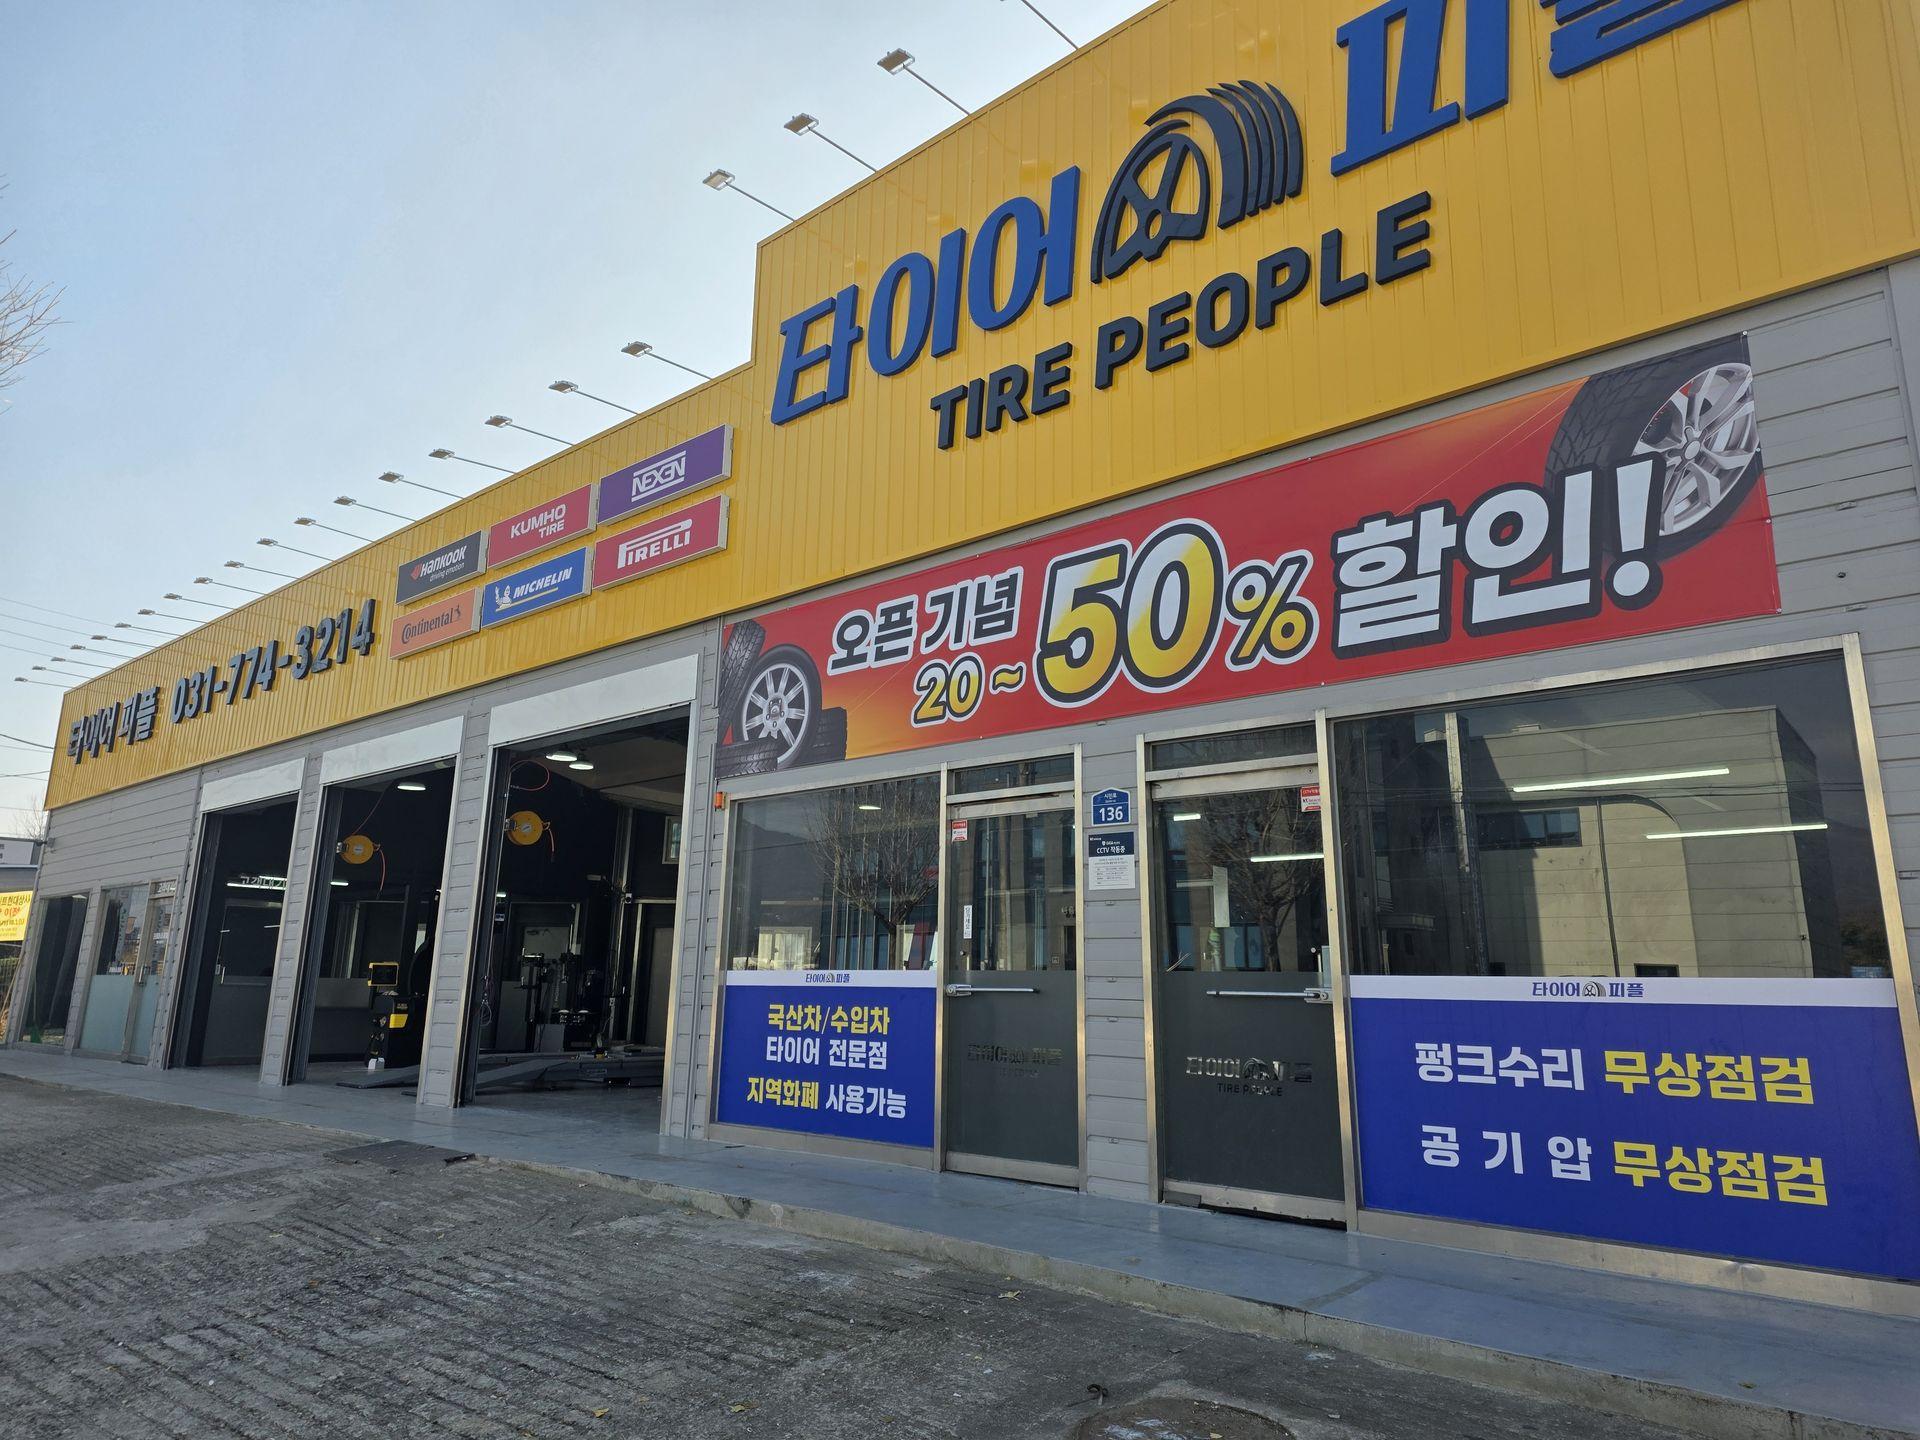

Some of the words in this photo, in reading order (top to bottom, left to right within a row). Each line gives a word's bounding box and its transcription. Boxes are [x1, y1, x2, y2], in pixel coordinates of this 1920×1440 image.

[772, 165, 1080, 425] 타이어
[930, 342, 1073, 450] TIRE
[1094, 191, 1431, 390] PEOPLE
[631, 453, 686, 500] NEXEN
[511, 503, 566, 539] KUMHO
[539, 519, 565, 539] TIRE
[617, 519, 692, 569] PIRELLI
[513, 566, 573, 599] MICHELIN
[1035, 518, 1319, 708] 50%
[1333, 454, 1664, 655] 할인!
[402, 608, 454, 644] Continental
[827, 595, 918, 676] 오픈
[921, 567, 1024, 654] 기념
[68, 700, 120, 765] 타이어
[118, 686, 160, 746] 피플
[170, 599, 376, 724] 031-774-3214
[1099, 805, 1124, 822] 136
[805, 973, 826, 983] 타이어
[836, 973, 851, 983] 피플
[1532, 981, 1582, 998] 타이어
[1608, 982, 1645, 998] 피플
[768, 1003, 890, 1036] 국산차/수입차
[766, 1036, 820, 1065] 타이어
[829, 1039, 888, 1070] 전문점
[1217, 1083, 1240, 1094] TIRE
[1415, 1042, 1585, 1091] 펑크수리
[1604, 1050, 1815, 1105] 무상점검
[746, 1077, 820, 1110] 지역화폐
[825, 1083, 907, 1120] 사용가능
[1613, 1141, 1829, 1207] 무상점검
